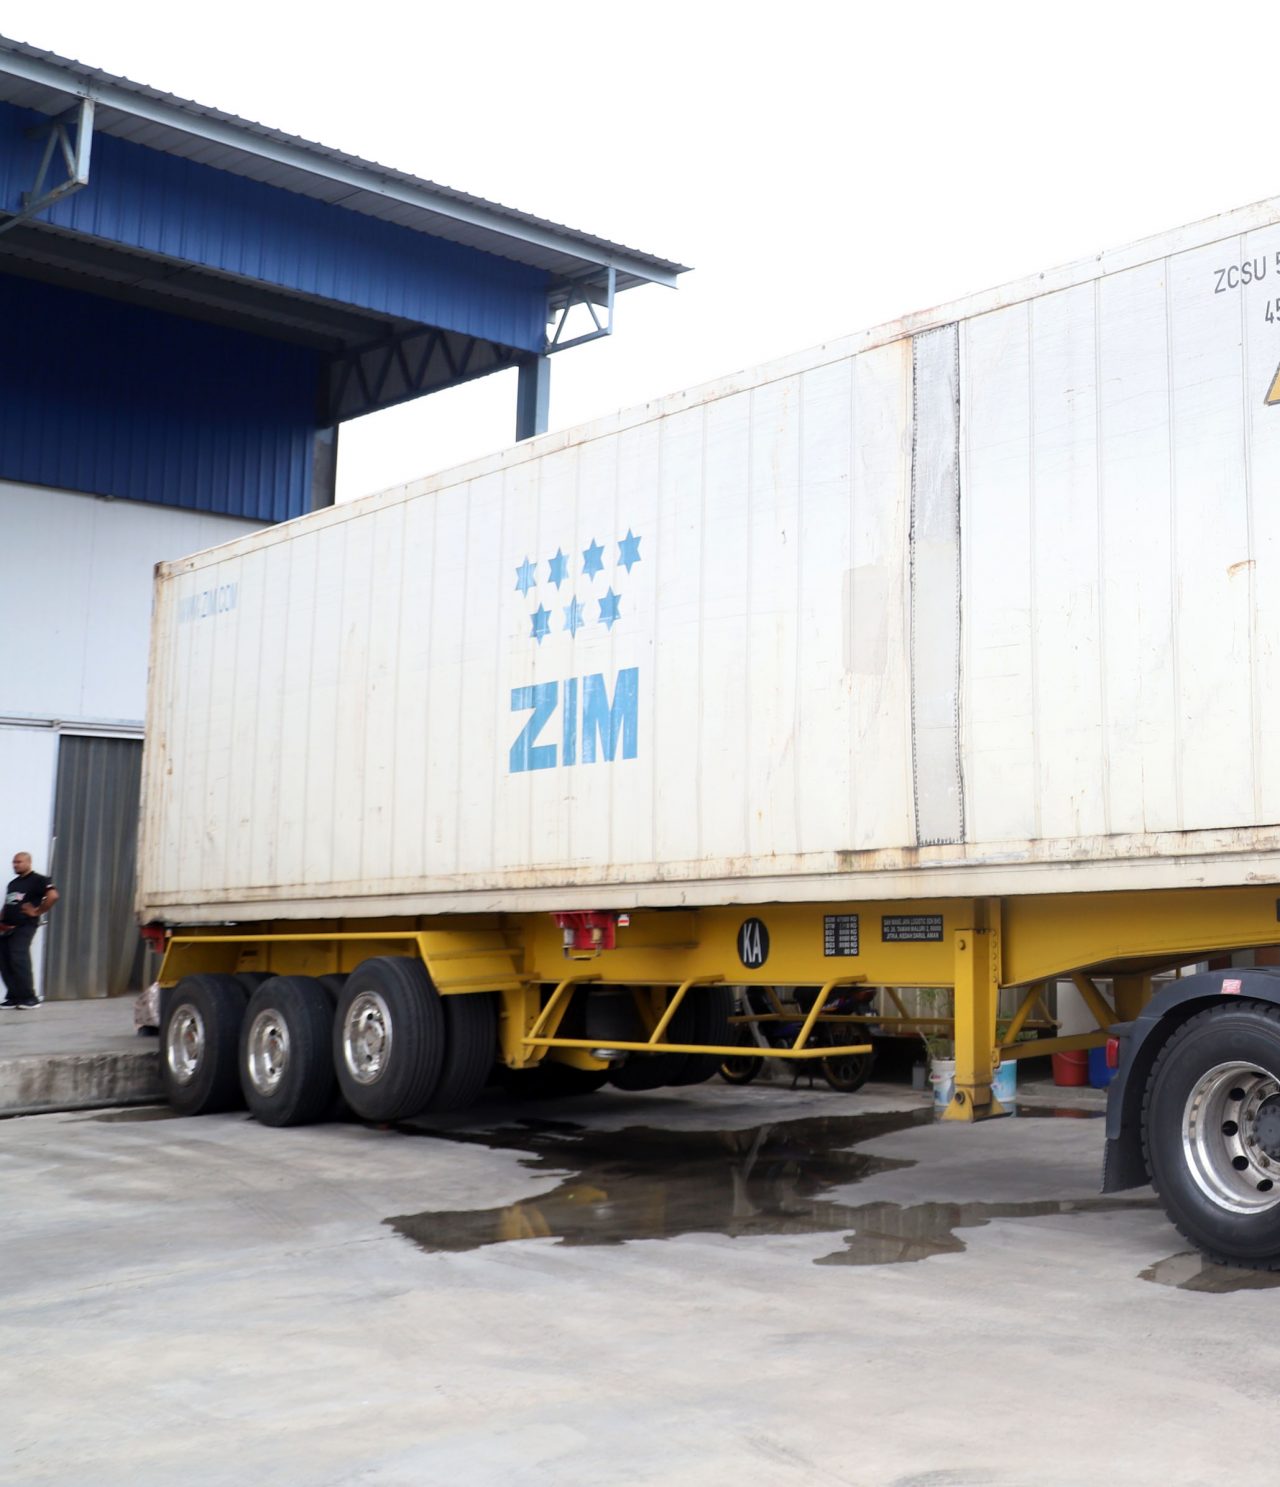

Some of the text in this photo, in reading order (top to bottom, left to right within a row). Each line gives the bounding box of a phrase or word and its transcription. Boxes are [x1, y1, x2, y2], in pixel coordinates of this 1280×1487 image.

[1213, 256, 1267, 294] ZCSU
[509, 667, 640, 773] ZIM
[743, 922, 762, 963] KA
